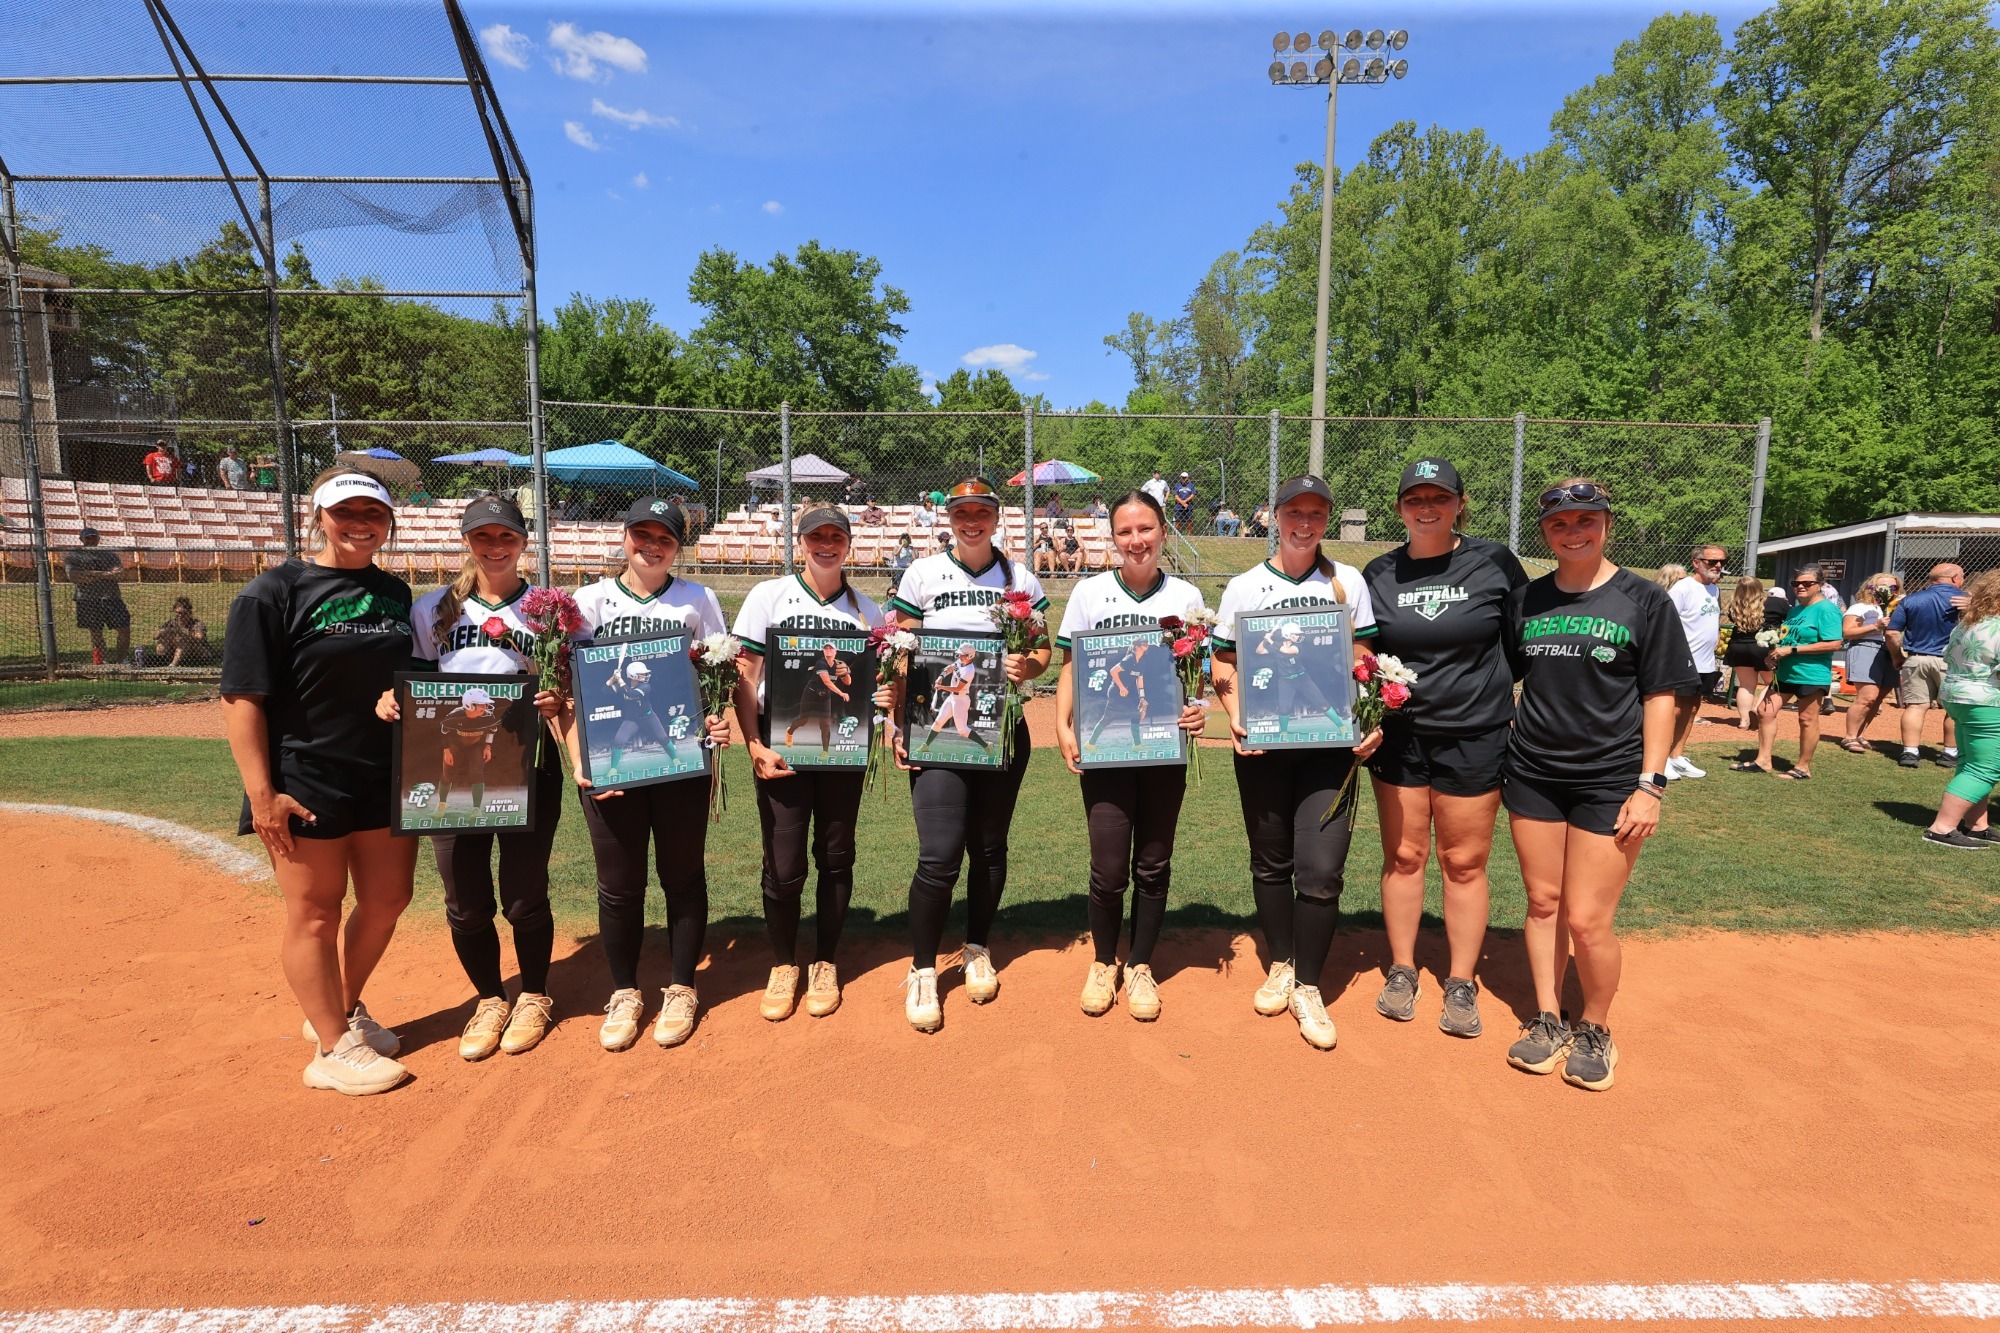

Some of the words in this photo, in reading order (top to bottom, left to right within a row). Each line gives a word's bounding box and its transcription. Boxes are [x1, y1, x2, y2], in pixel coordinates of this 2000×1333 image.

[934, 590, 1002, 611] GREENSBO
[1397, 586, 1469, 604] SOFTBALL
[324, 623, 390, 635] SOFTBALL
[1521, 614, 1630, 649] GREENSBORO
[1525, 644, 1581, 657] SOFTBALL
[784, 658, 800, 669] #8
[981, 658, 997, 669] #9
[1088, 657, 1107, 669] #10
[1088, 676, 1104, 691] GC
[1252, 675, 1269, 690] GC
[415, 707, 436, 719] #6
[668, 704, 685, 717] #7
[976, 700, 992, 715] GC
[589, 709, 622, 722] CONGER
[838, 722, 855, 738] GC
[973, 720, 996, 728] EBERT
[1250, 726, 1280, 734] FRAZIER
[668, 724, 687, 740] GC
[1142, 731, 1172, 740] HAMPEL
[1247, 732, 1354, 744] COLLEGE
[835, 744, 860, 752] HYATT
[783, 756, 868, 765] OLLEGE
[909, 751, 1003, 765] COLLEGE
[1081, 749, 1181, 763] COLLEGE
[592, 760, 705, 788] COLLEGE
[408, 790, 429, 808] GC
[485, 804, 520, 813] TAYLOR
[400, 815, 528, 829] COLLEGE
